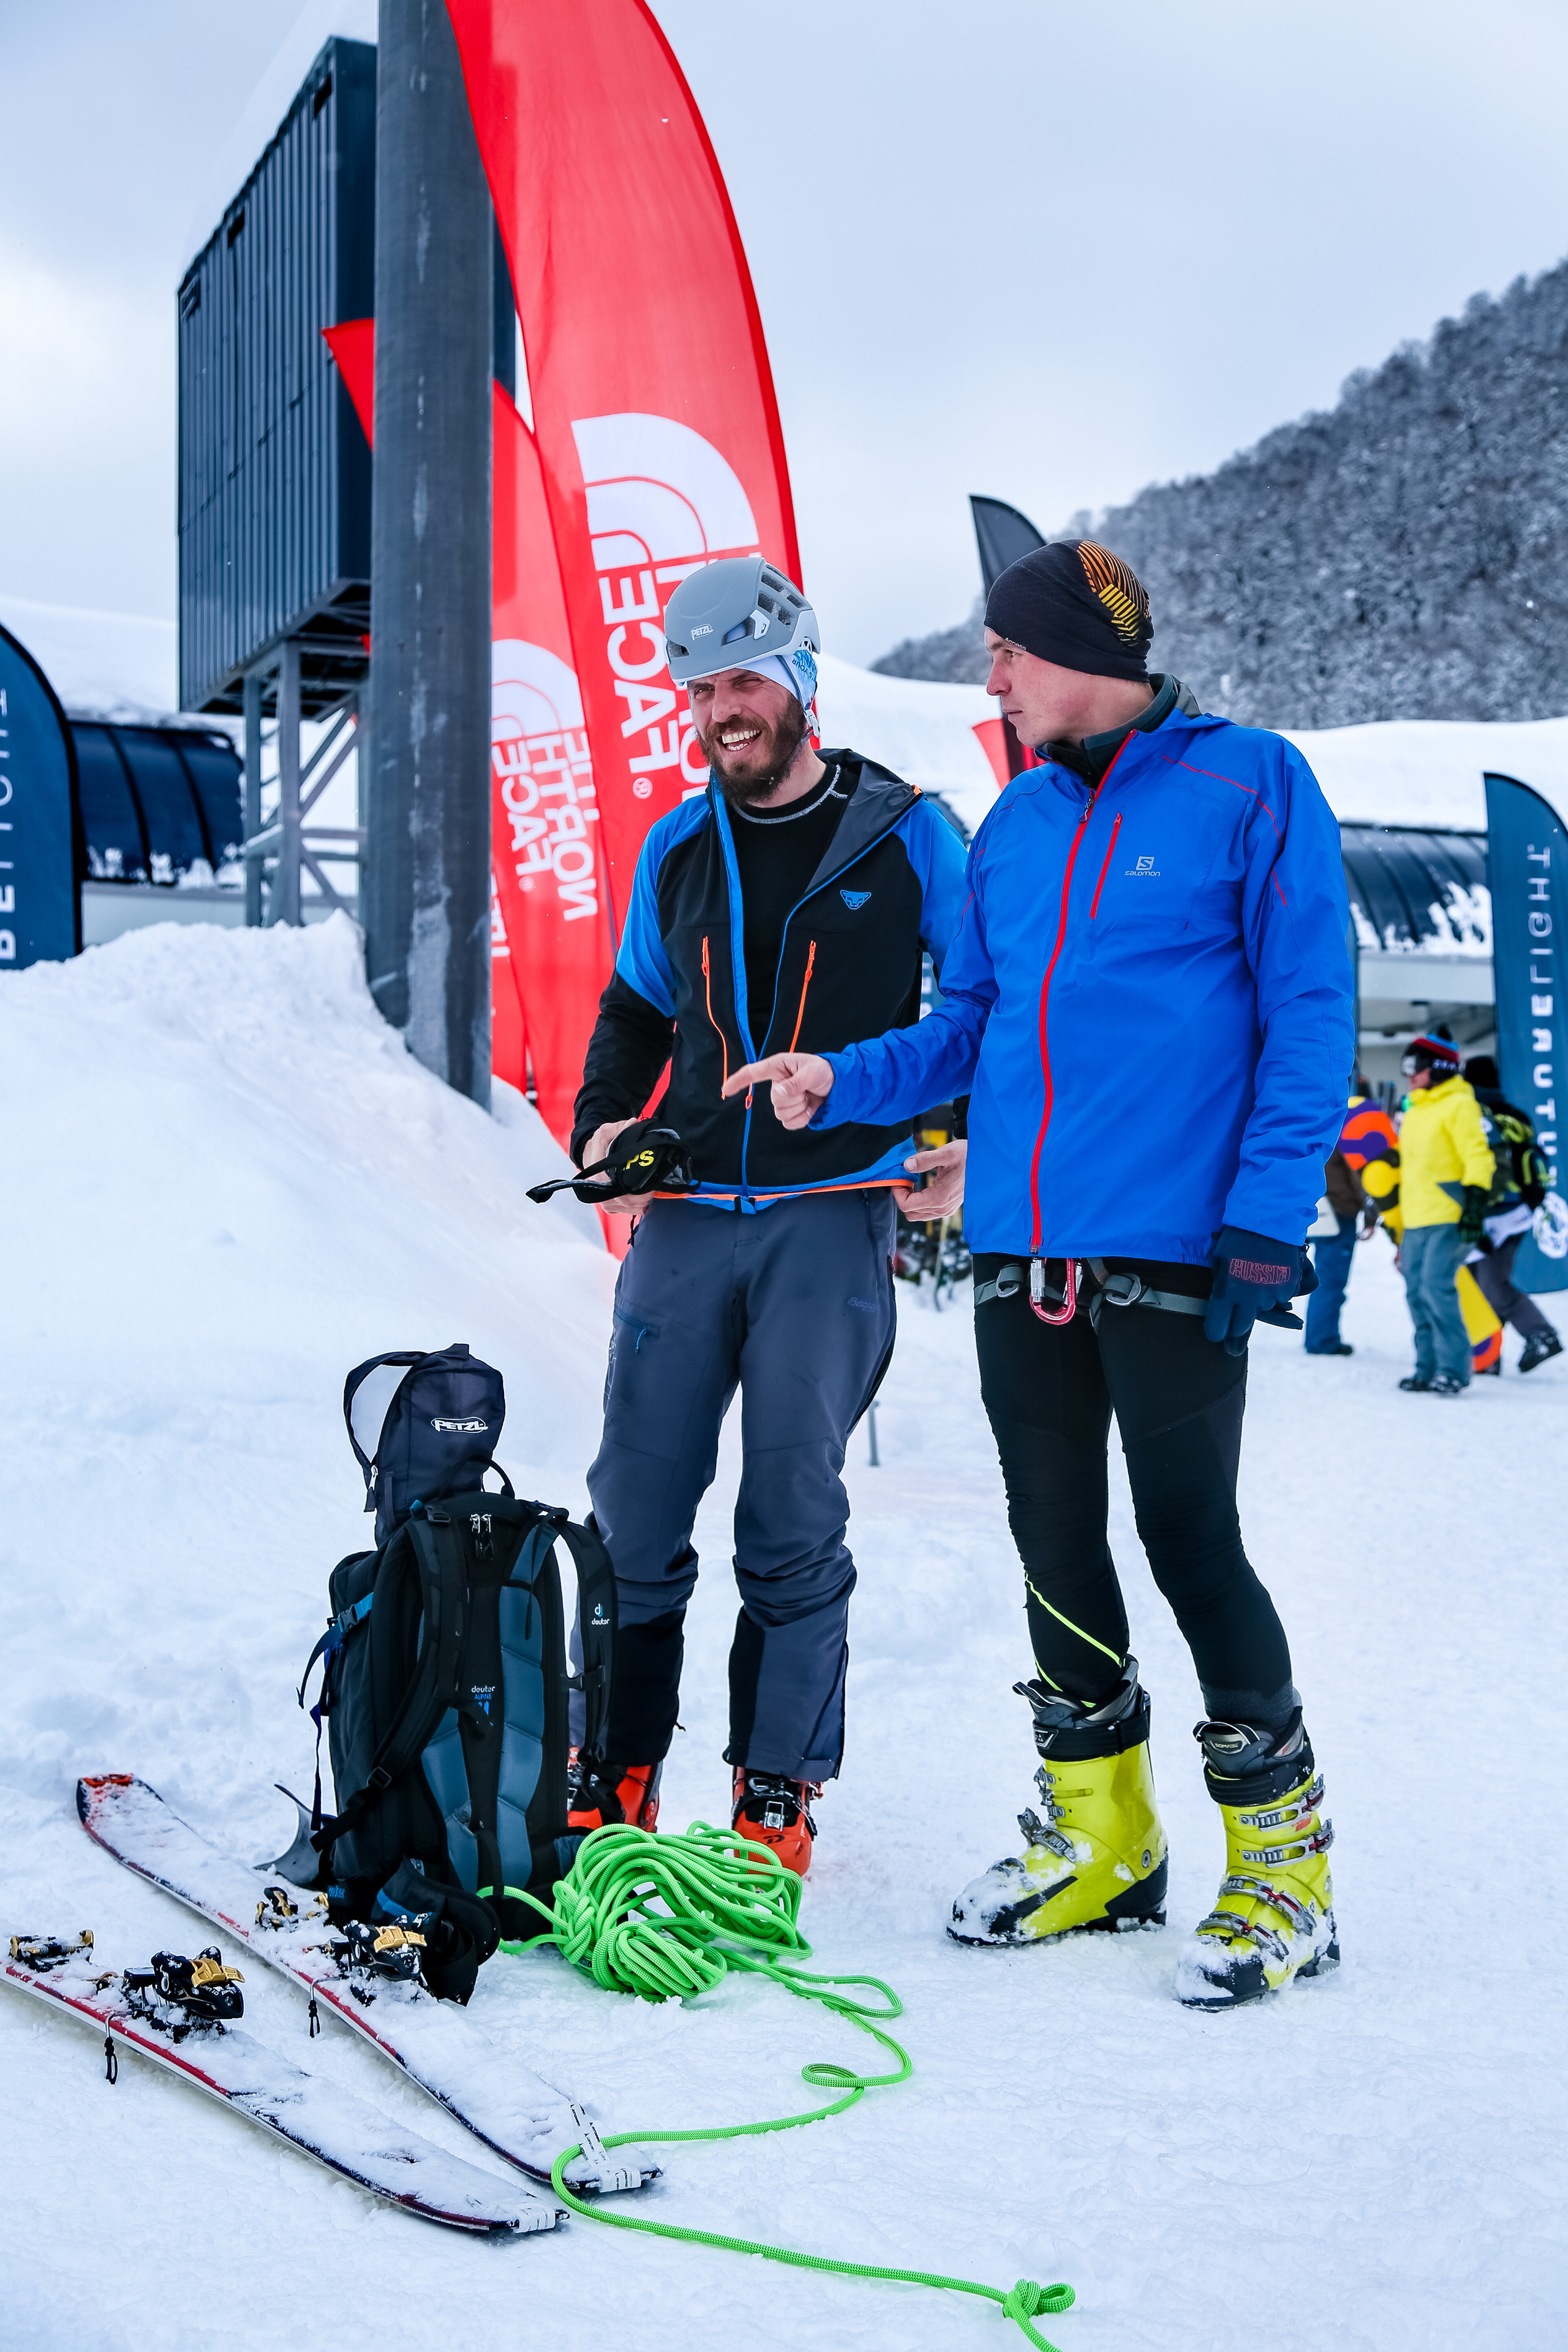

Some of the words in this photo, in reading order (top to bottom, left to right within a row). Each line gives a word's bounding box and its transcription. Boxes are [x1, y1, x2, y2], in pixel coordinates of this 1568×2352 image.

[691, 625, 714, 641] PETZL
[791, 658, 809, 675] YOUR
[1229, 1258, 1291, 1284] RUSSIA
[434, 1420, 489, 1432] PETZL
